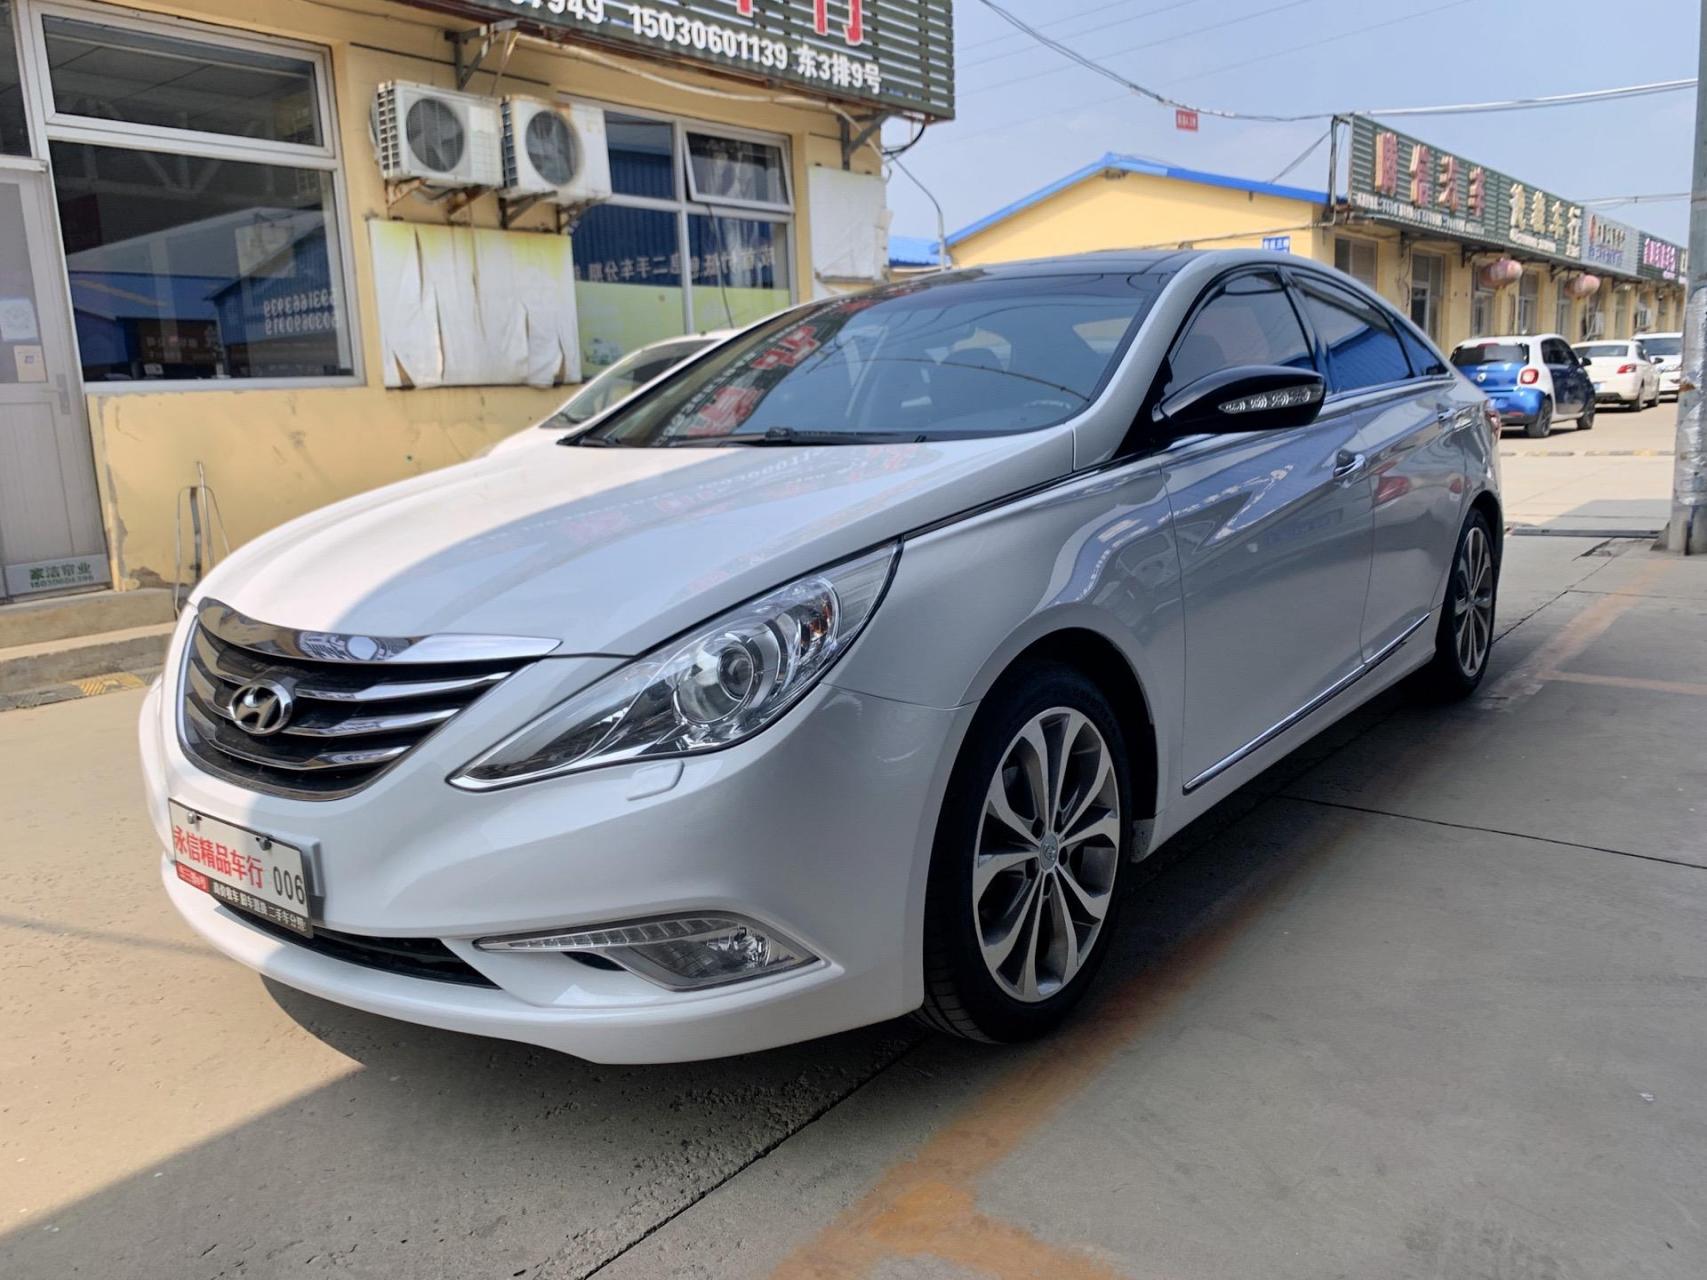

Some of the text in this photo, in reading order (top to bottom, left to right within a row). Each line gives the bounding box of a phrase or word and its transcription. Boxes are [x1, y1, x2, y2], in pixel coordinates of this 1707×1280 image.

[628, 7, 788, 70] 15030601139
[797, 44, 882, 95] 东3排9号
[173, 825, 263, 888] 永信精品车行
[273, 866, 305, 905] 006
